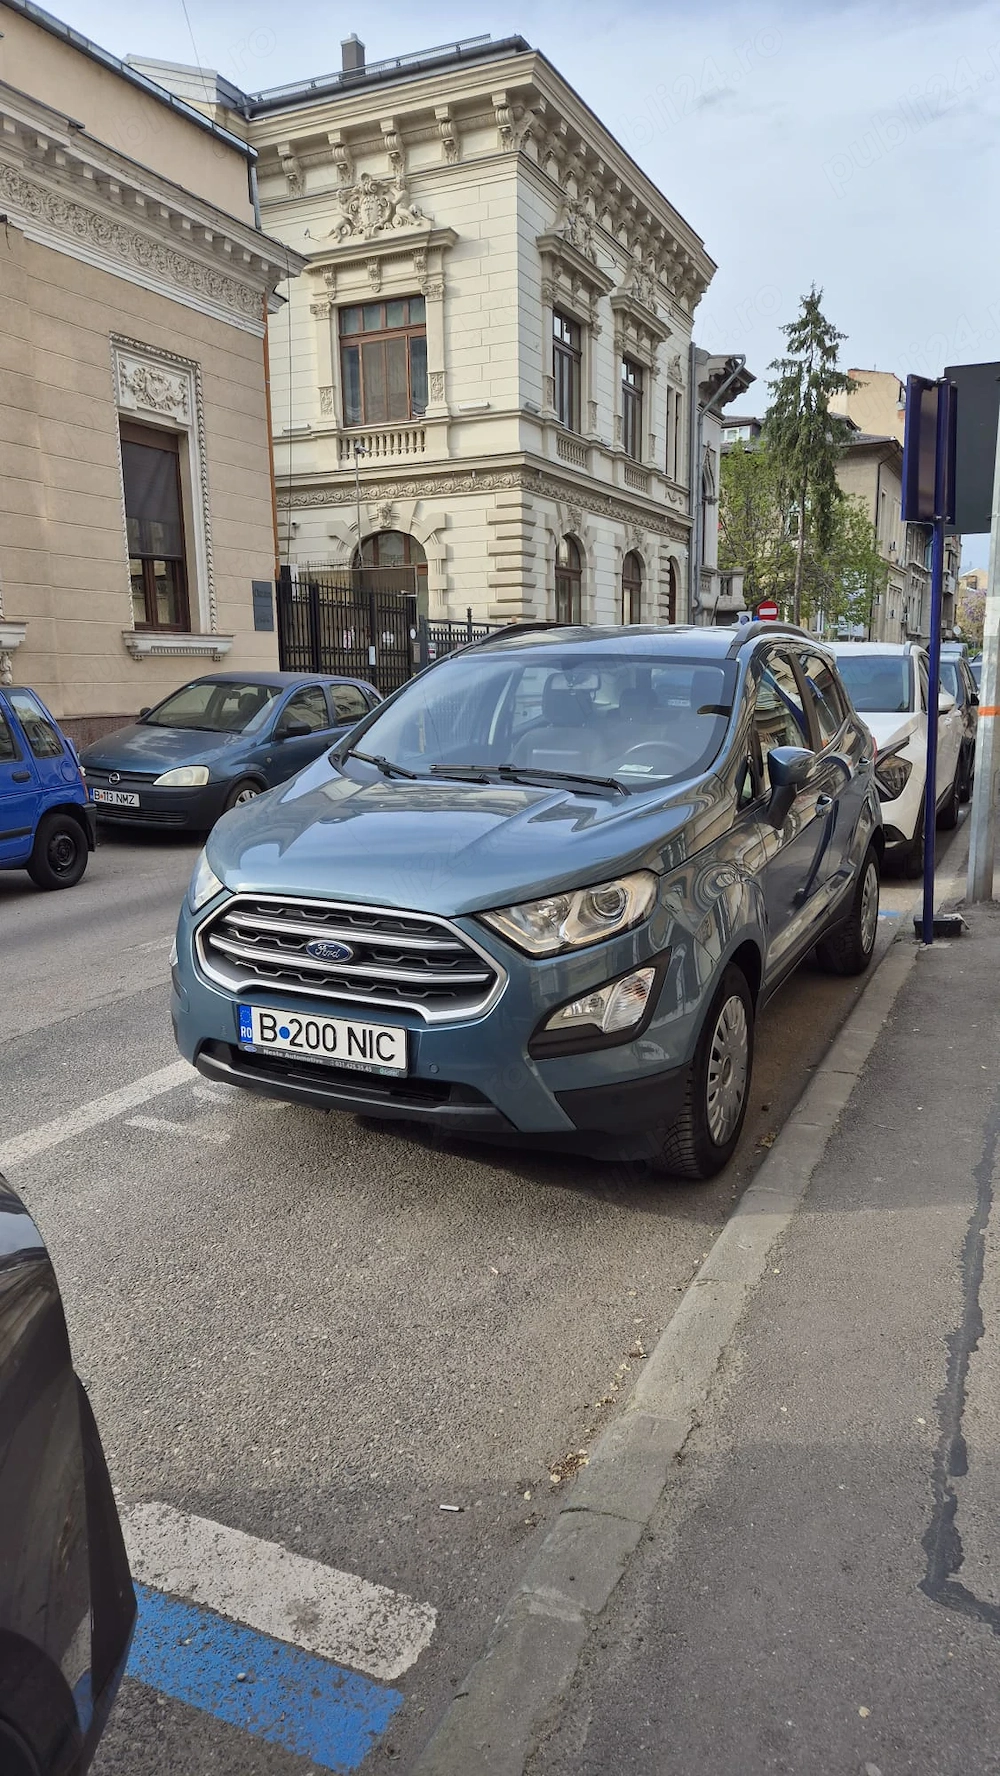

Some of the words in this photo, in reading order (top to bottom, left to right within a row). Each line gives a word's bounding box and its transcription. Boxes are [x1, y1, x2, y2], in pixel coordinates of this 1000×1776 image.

[94, 790, 101, 800] B
[103, 791, 114, 802] 113
[116, 793, 135, 804] NMZ
[314, 943, 341, 958] Ford
[240, 1025, 252, 1039] RO
[259, 1013, 278, 1042] B
[288, 1018, 337, 1052] 200
[347, 1026, 396, 1062] NIC
